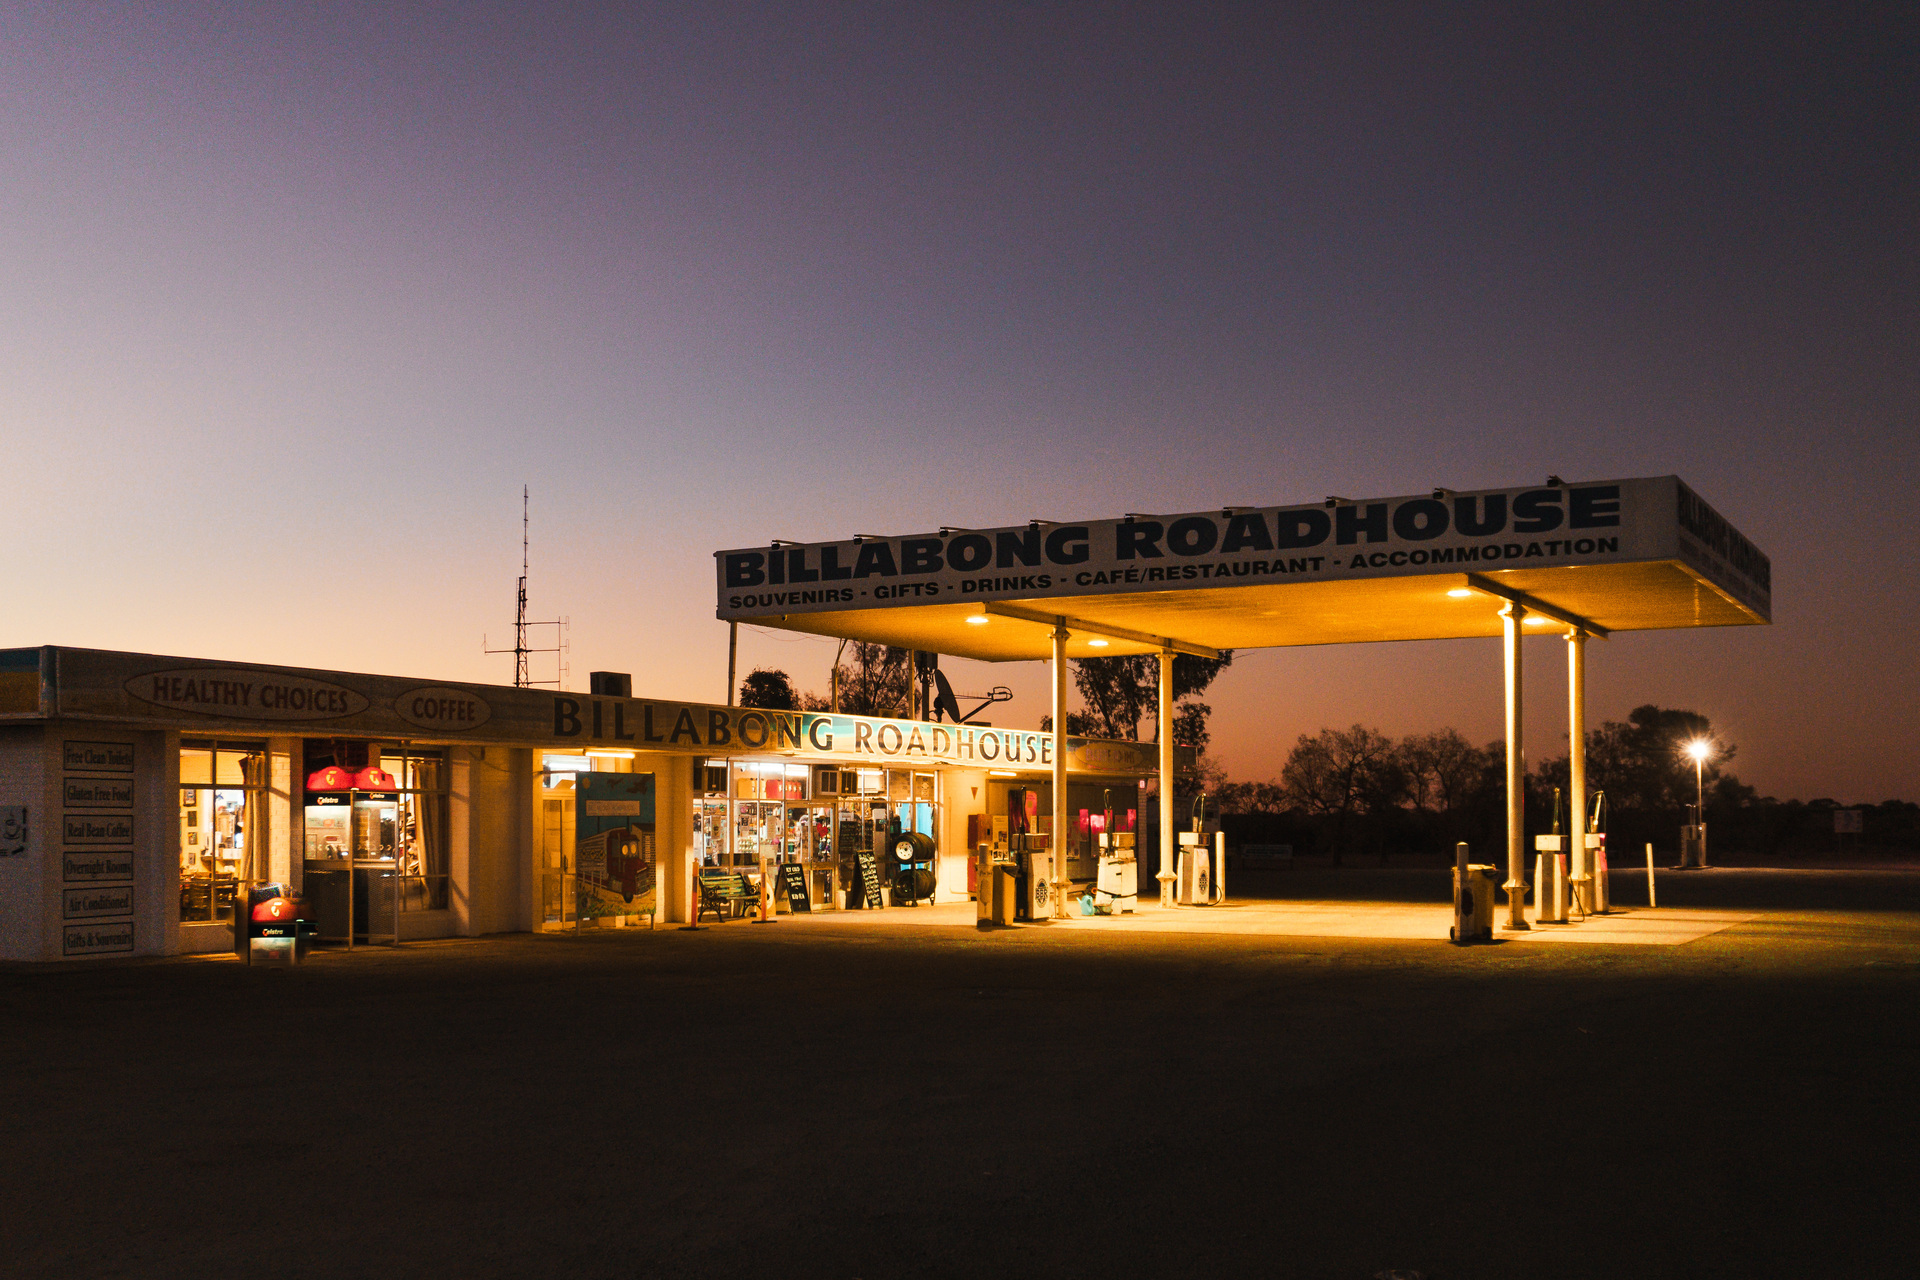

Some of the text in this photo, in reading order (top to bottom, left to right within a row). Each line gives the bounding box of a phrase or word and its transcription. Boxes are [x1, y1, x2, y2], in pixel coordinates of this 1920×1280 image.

[726, 526, 1090, 588] BILLABONG
[1116, 486, 1620, 560] ROADHOUSE
[729, 537, 1619, 609] SOUVENIRS GIFTS DRINKS CAFÉ/RESTAURANT ACCOMMODATION
[153, 676, 348, 713] HEALTHY CHOICES
[412, 697, 476, 722] COFFEE
[553, 698, 1053, 765] BILLABONG ROADHOUSE
[67, 785, 130, 801] Gluten Free Food
[317, 797, 339, 805] Telstra
[68, 823, 130, 837] Real Bean Coffee
[66, 859, 131, 878] Overnight Rooms
[262, 929, 284, 937] Telstra
